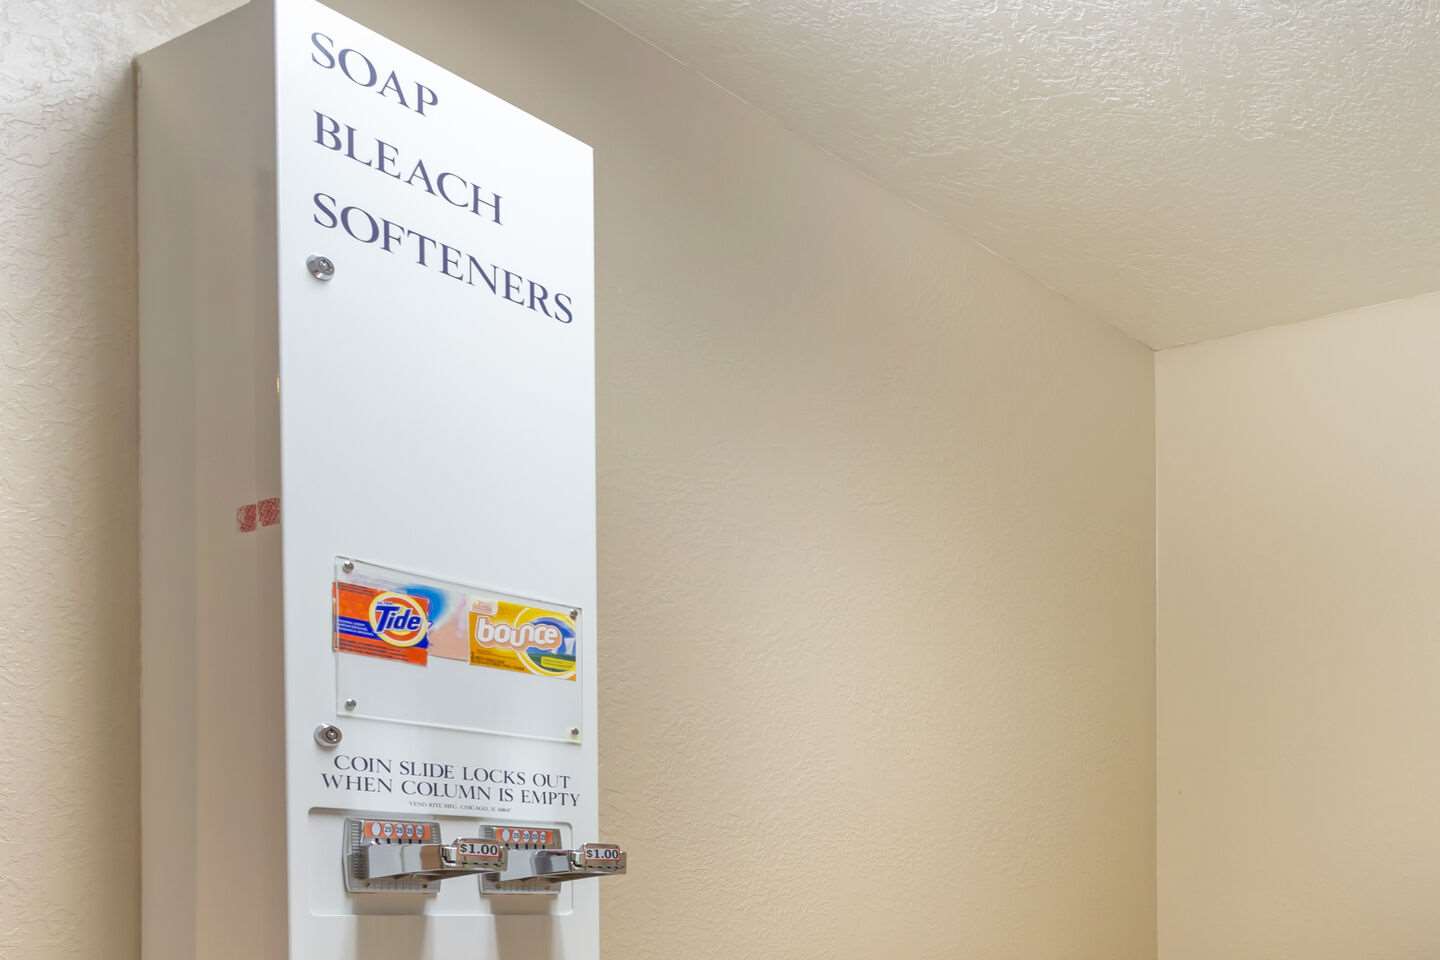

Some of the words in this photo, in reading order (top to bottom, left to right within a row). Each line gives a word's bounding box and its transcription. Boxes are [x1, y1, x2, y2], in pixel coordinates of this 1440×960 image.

[311, 32, 439, 116] SOAP
[313, 110, 503, 225] BLEACH
[313, 192, 573, 324] SOFTENERS
[375, 605, 422, 632] Tide
[477, 616, 558, 647] bounce
[334, 754, 392, 774] COIN
[400, 760, 456, 780] SLIDE
[463, 766, 526, 786] LOCKS
[533, 773, 571, 790] OUT
[321, 773, 393, 794] WHEN
[401, 780, 491, 801] COLUMN
[499, 787, 514, 803] IS
[521, 790, 581, 807] EMPTY
[460, 843, 498, 856] $1.00
[586, 848, 619, 860] $1.00
